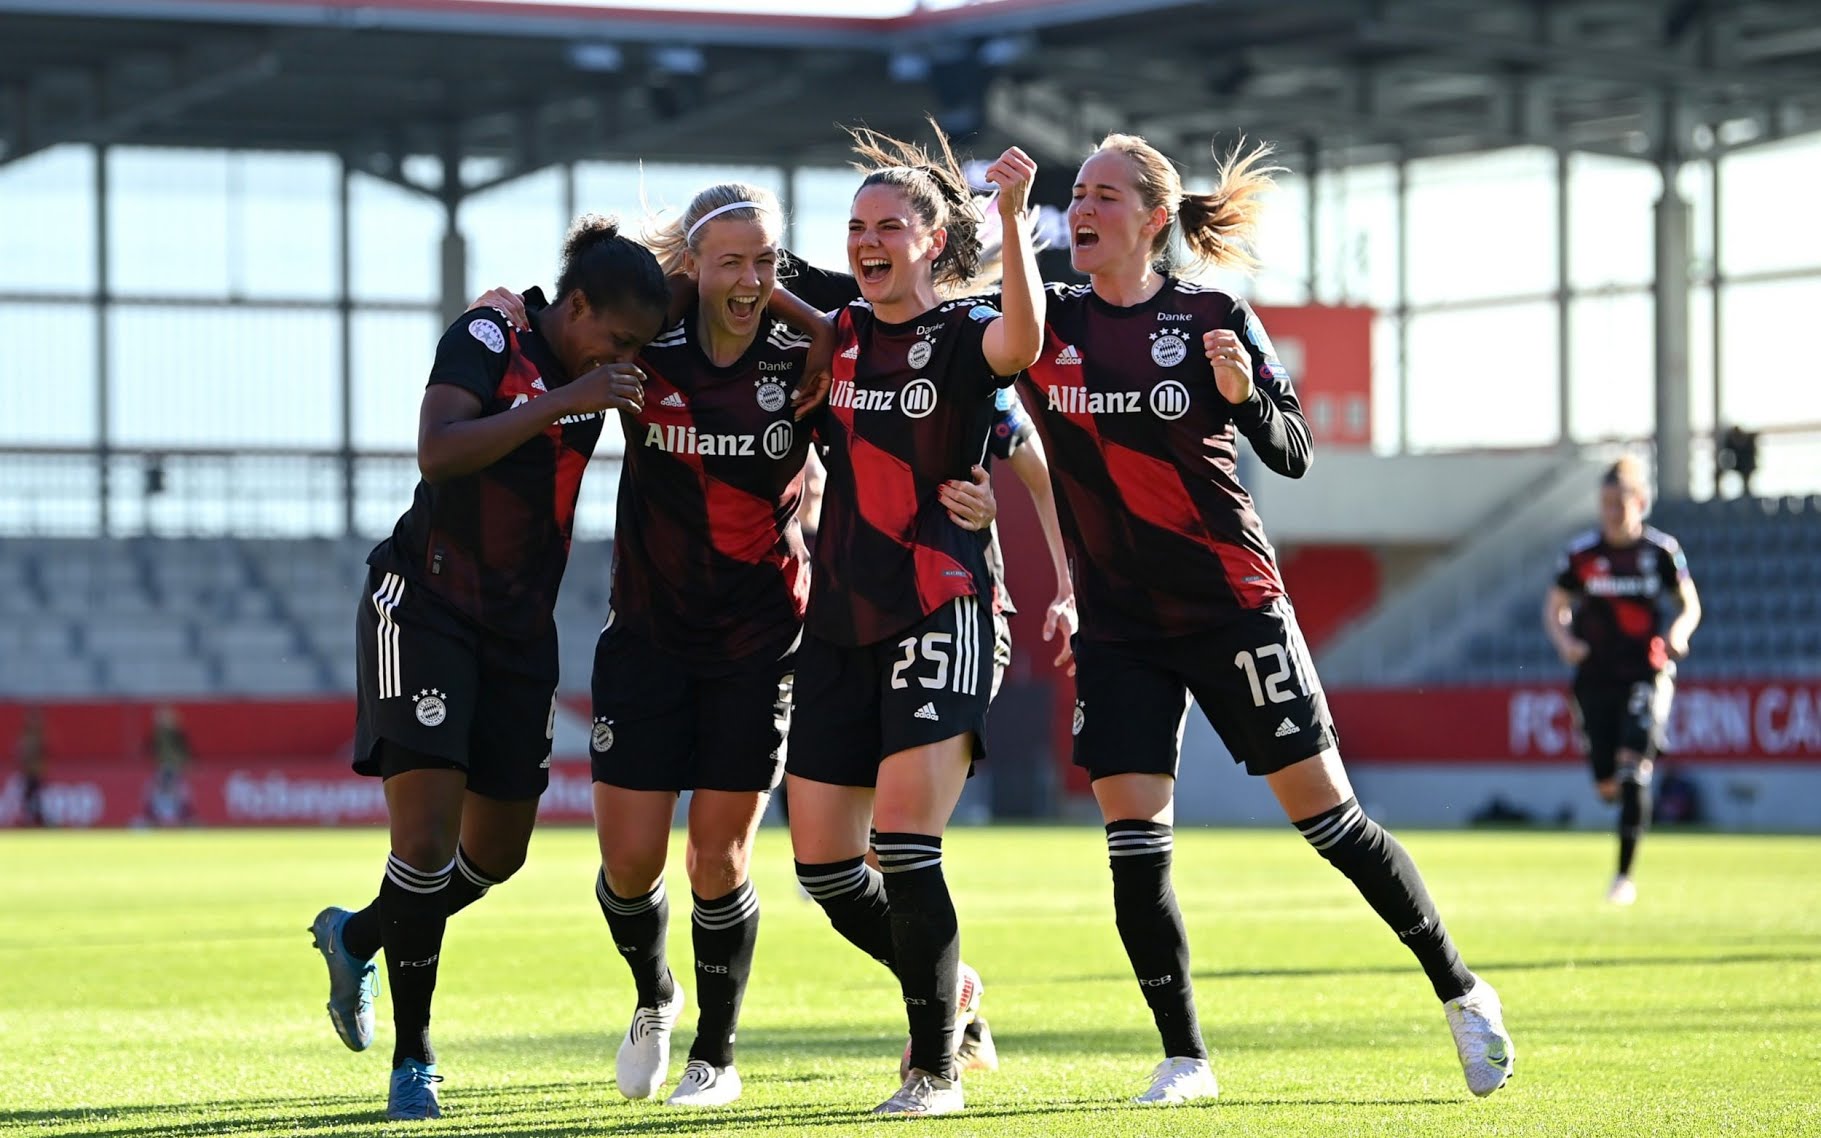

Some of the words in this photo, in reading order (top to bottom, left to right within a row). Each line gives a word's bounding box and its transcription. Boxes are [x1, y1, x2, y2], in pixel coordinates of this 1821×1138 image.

[1157, 312, 1193, 321] Danke
[758, 360, 793, 371] Danke
[1055, 356, 1082, 365] adidas
[828, 378, 896, 411] llianz
[1048, 384, 1142, 414] Allianz
[644, 422, 755, 456] Allianz
[890, 632, 952, 690] 25
[1234, 643, 1297, 707] 12
[914, 711, 939, 721] adidas
[1509, 690, 1567, 755] FC
[1755, 688, 1821, 754] CA
[1275, 726, 1300, 737] adidas
[1400, 916, 1429, 938] FCB
[697, 960, 728, 974] FCB
[1140, 975, 1172, 987] FCB
